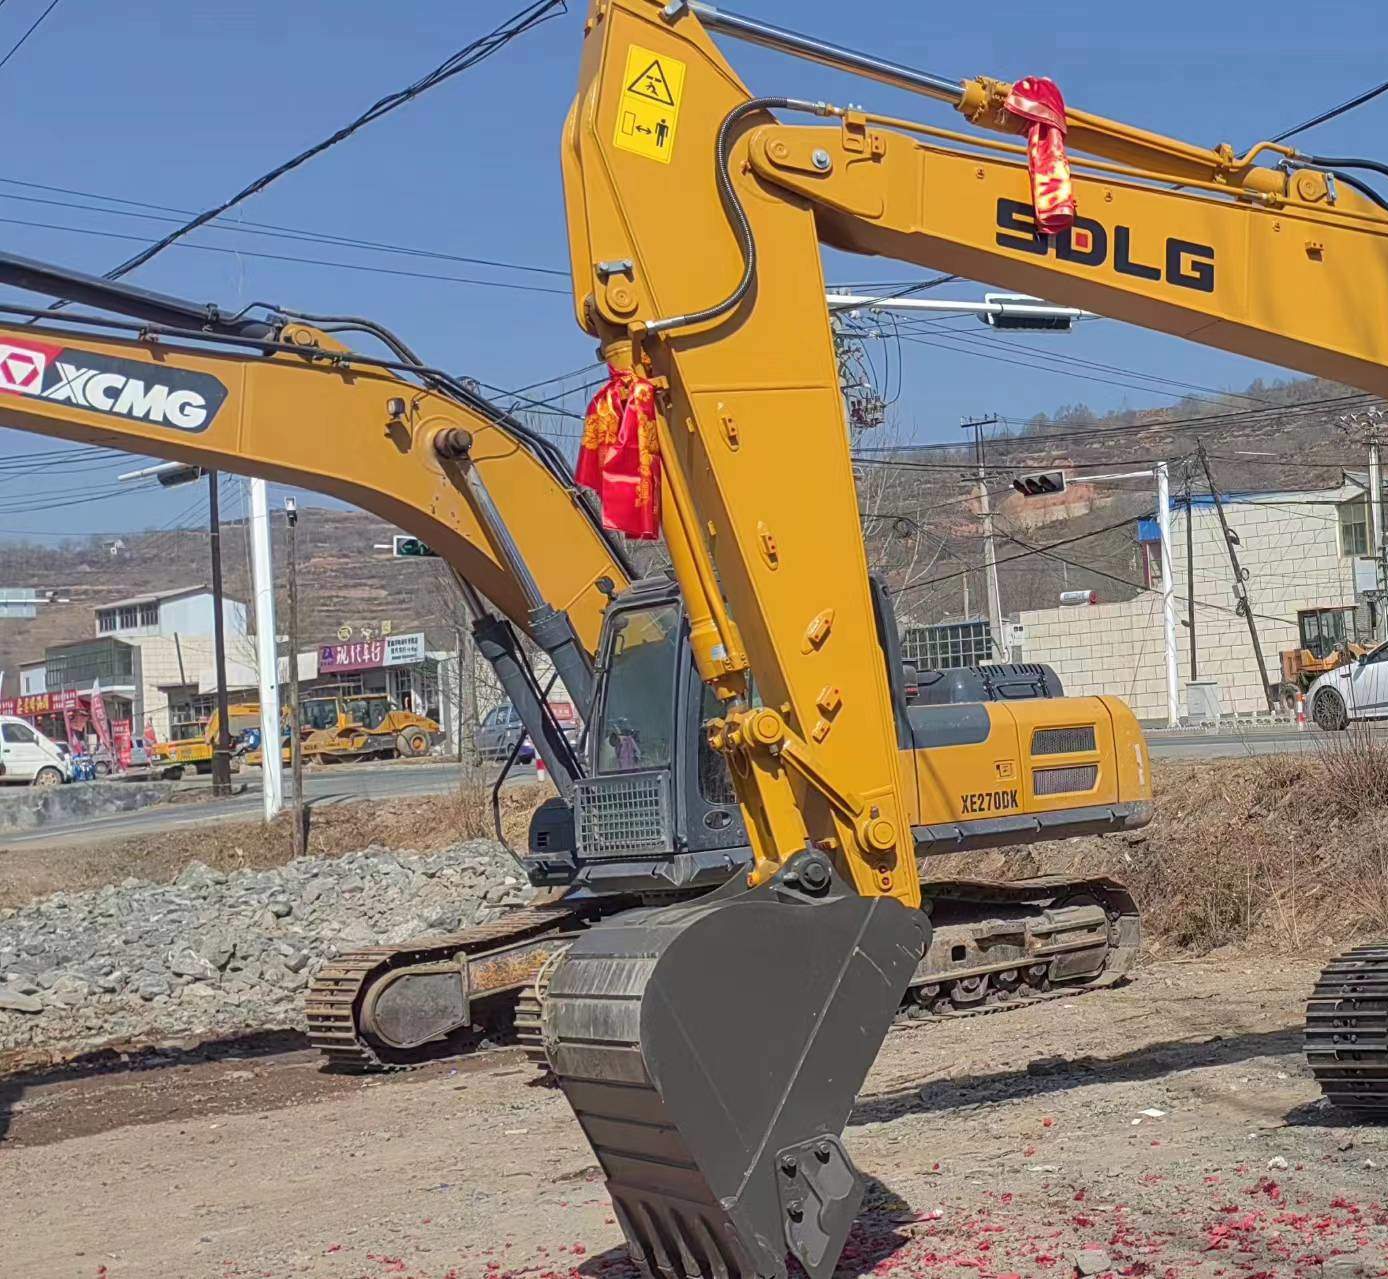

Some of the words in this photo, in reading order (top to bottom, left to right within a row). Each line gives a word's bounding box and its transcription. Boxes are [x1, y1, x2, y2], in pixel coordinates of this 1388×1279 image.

[996, 198, 1214, 292] SDLG
[41, 361, 207, 428] XCMG
[961, 790, 1019, 814] XE270DK
